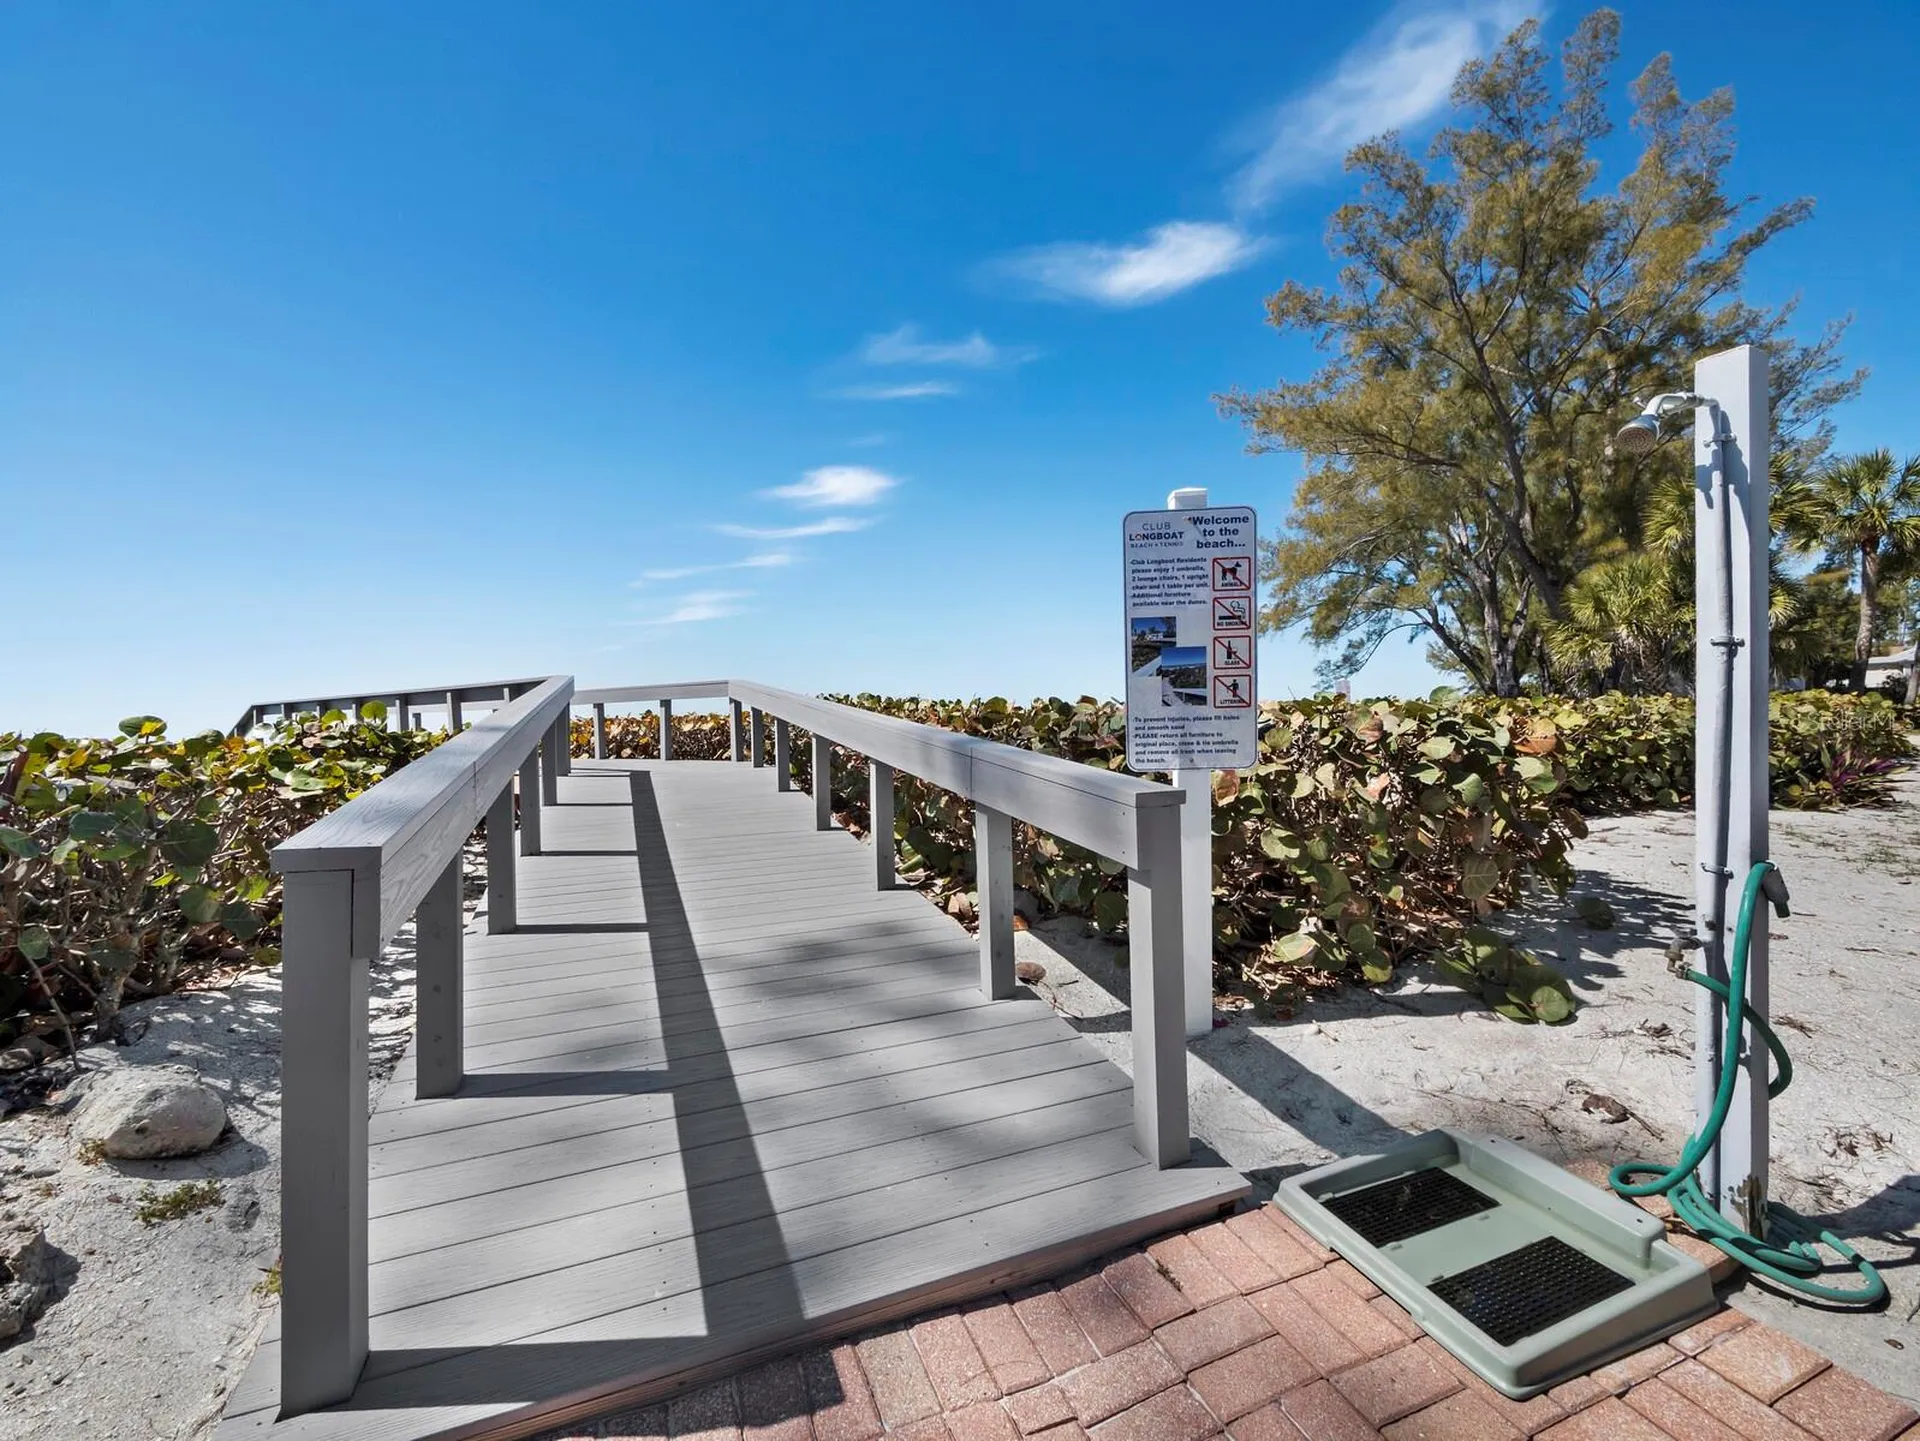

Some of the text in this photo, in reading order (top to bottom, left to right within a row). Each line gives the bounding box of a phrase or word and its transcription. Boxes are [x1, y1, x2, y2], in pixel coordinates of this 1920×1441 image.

[1192, 515, 1249, 526] Welcome
[1142, 521, 1171, 531] CLUB
[1129, 531, 1184, 541] LONGBOAT
[1202, 527, 1239, 537] to the
[1196, 538, 1246, 549] beach...
[1147, 558, 1174, 566] Longboat
[1187, 573, 1209, 581] upright
